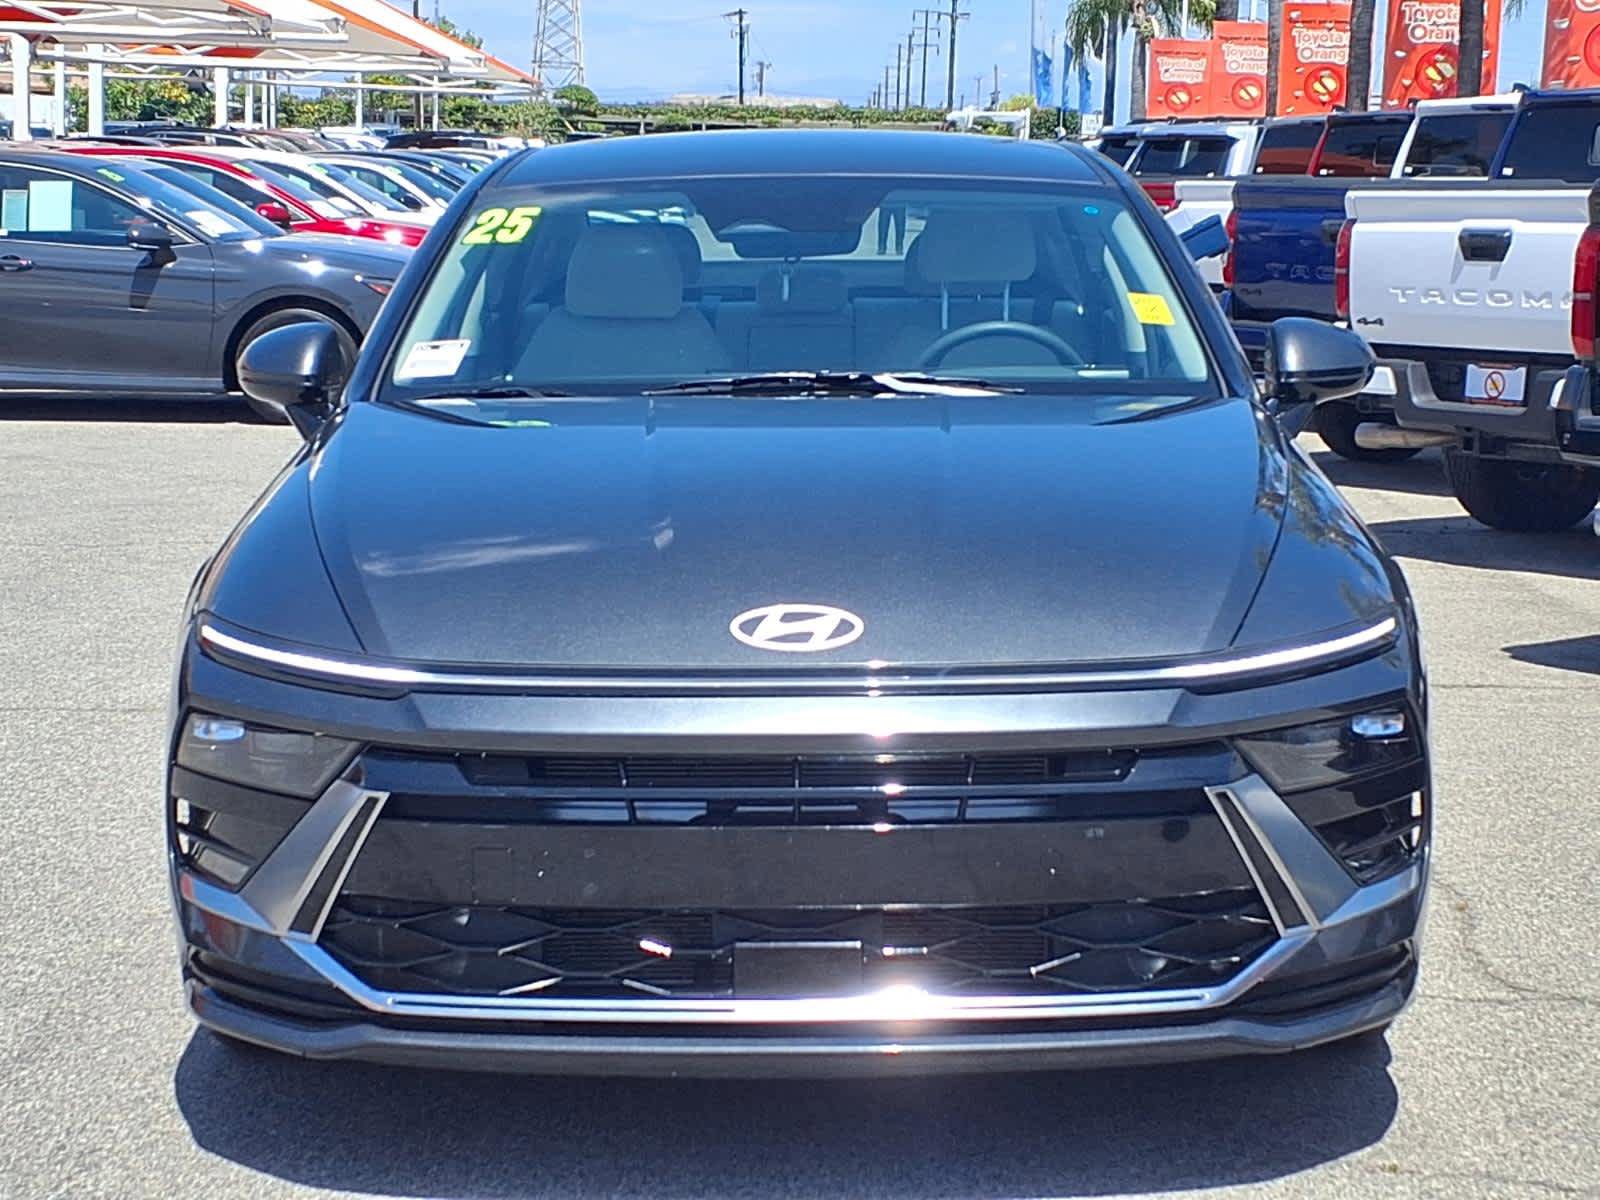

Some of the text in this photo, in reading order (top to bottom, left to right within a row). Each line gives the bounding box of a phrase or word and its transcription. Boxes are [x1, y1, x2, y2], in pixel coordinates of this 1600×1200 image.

[1294, 29, 1344, 45] Toyota
[1408, 23, 1456, 41] Oran
[1223, 45, 1265, 58] Toyota
[1299, 46, 1346, 61] Orang
[1228, 59, 1266, 73] Orang
[461, 206, 542, 244] 25
[1264, 262, 1335, 279] TAC
